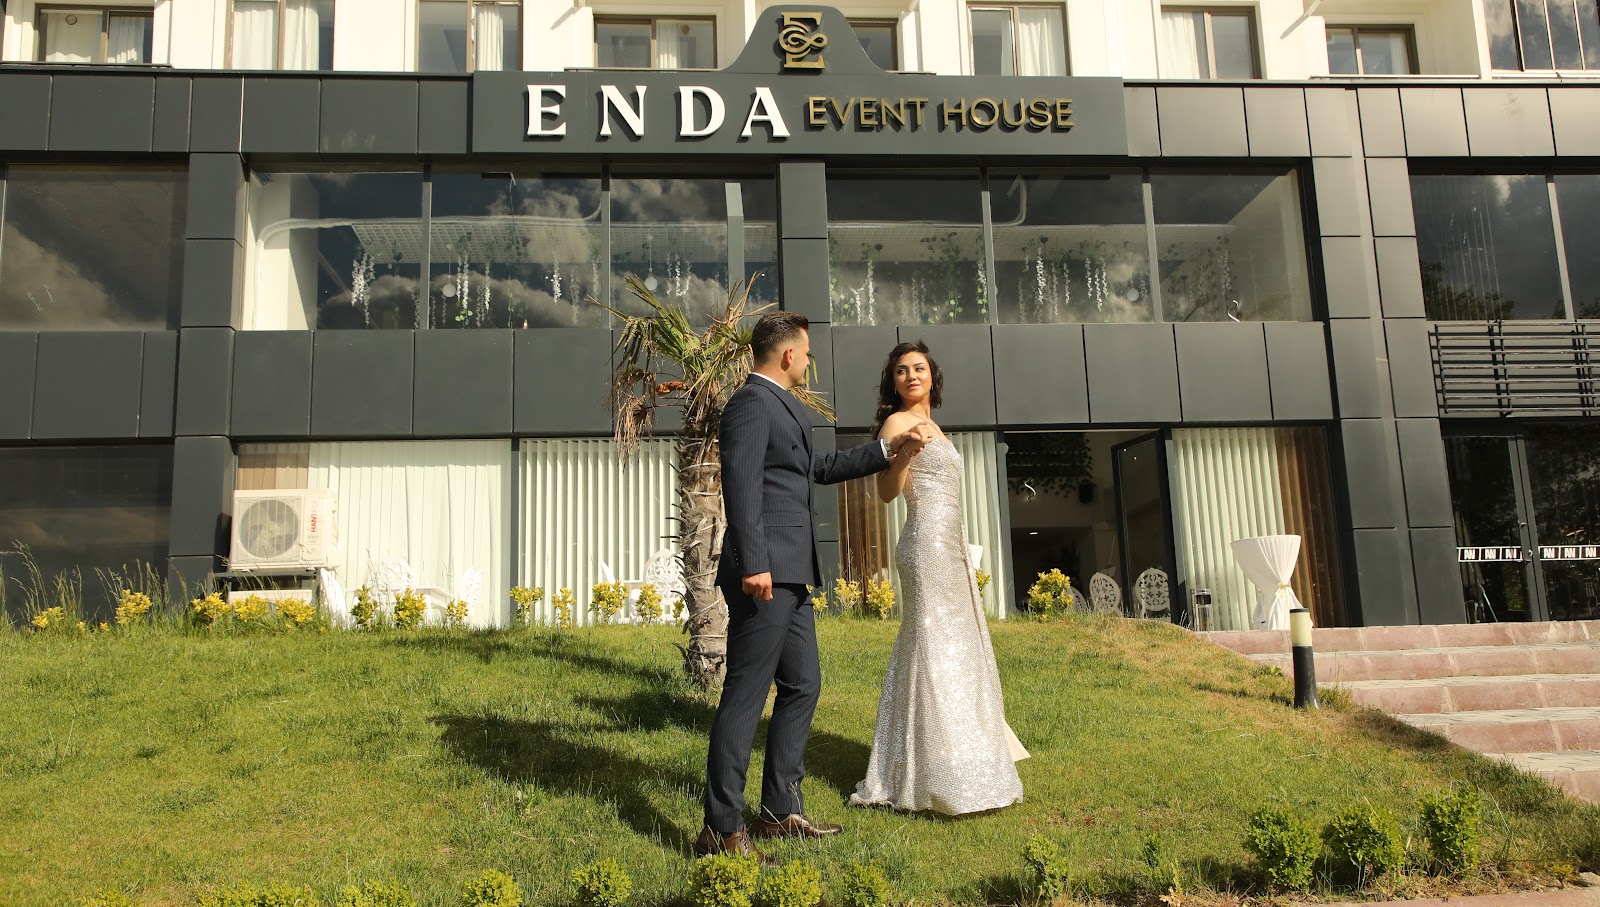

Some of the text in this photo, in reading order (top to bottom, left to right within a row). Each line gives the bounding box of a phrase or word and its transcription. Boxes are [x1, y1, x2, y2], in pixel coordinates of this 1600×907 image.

[526, 84, 1075, 137] ENDA EVENT HOUSE
